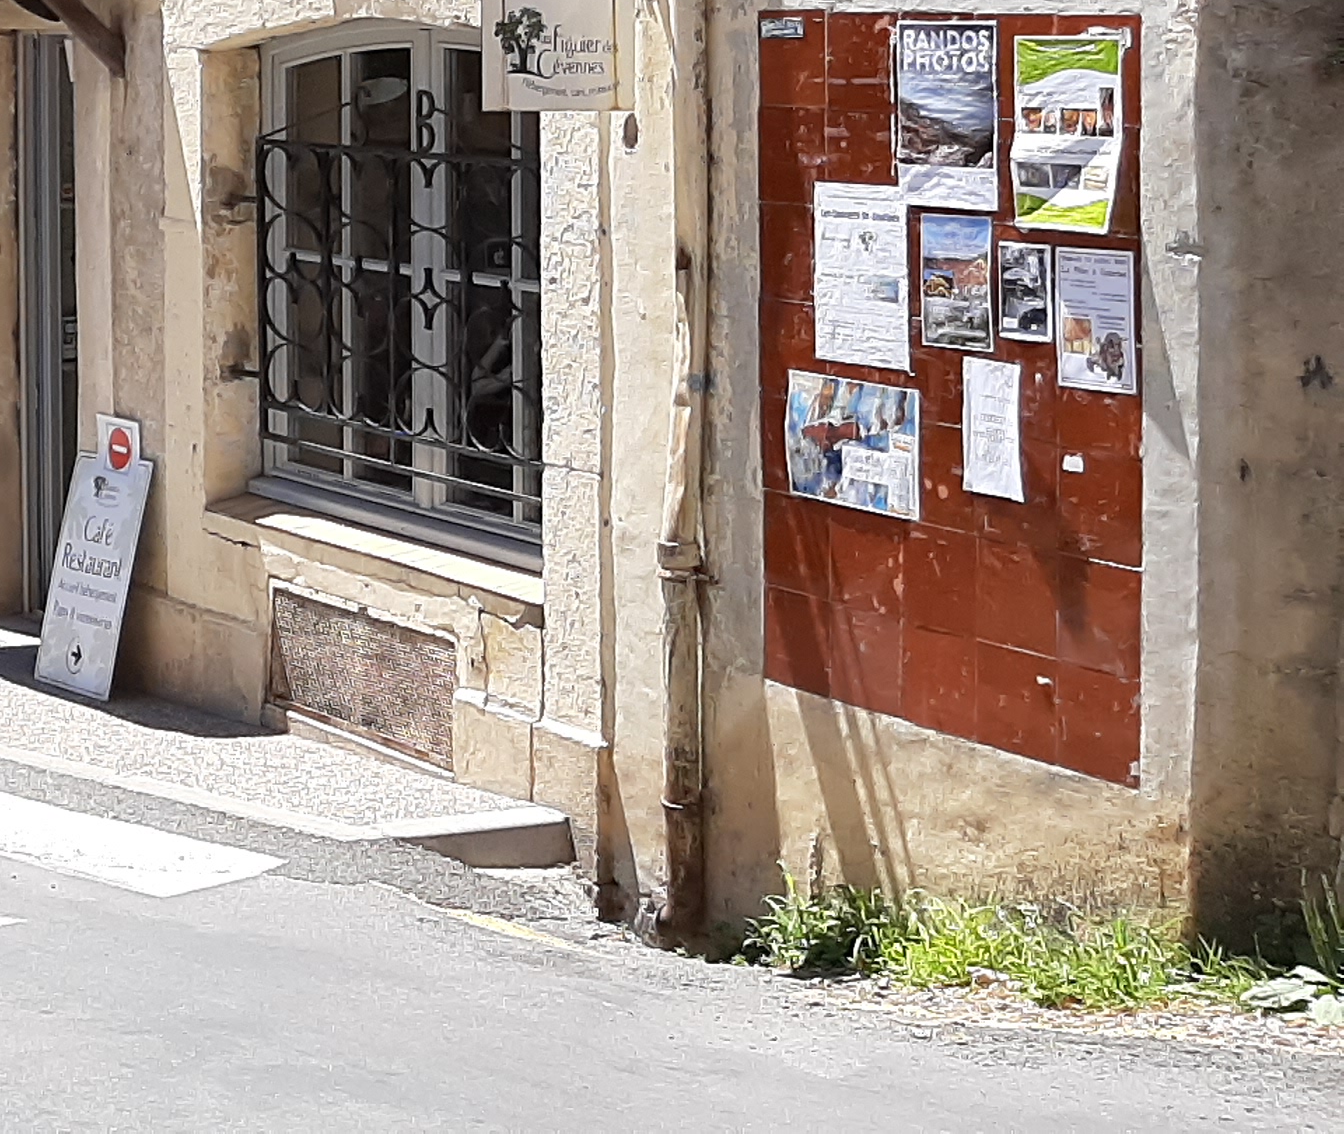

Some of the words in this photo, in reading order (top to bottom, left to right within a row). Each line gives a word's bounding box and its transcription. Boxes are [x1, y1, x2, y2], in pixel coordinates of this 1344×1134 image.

[553, 24, 602, 59] Figuier
[903, 29, 991, 51] RANDOS
[537, 49, 605, 79] Cévennes
[903, 51, 990, 72] PHOTOS
[84, 515, 114, 546] Café
[62, 542, 123, 579] Restaurant
